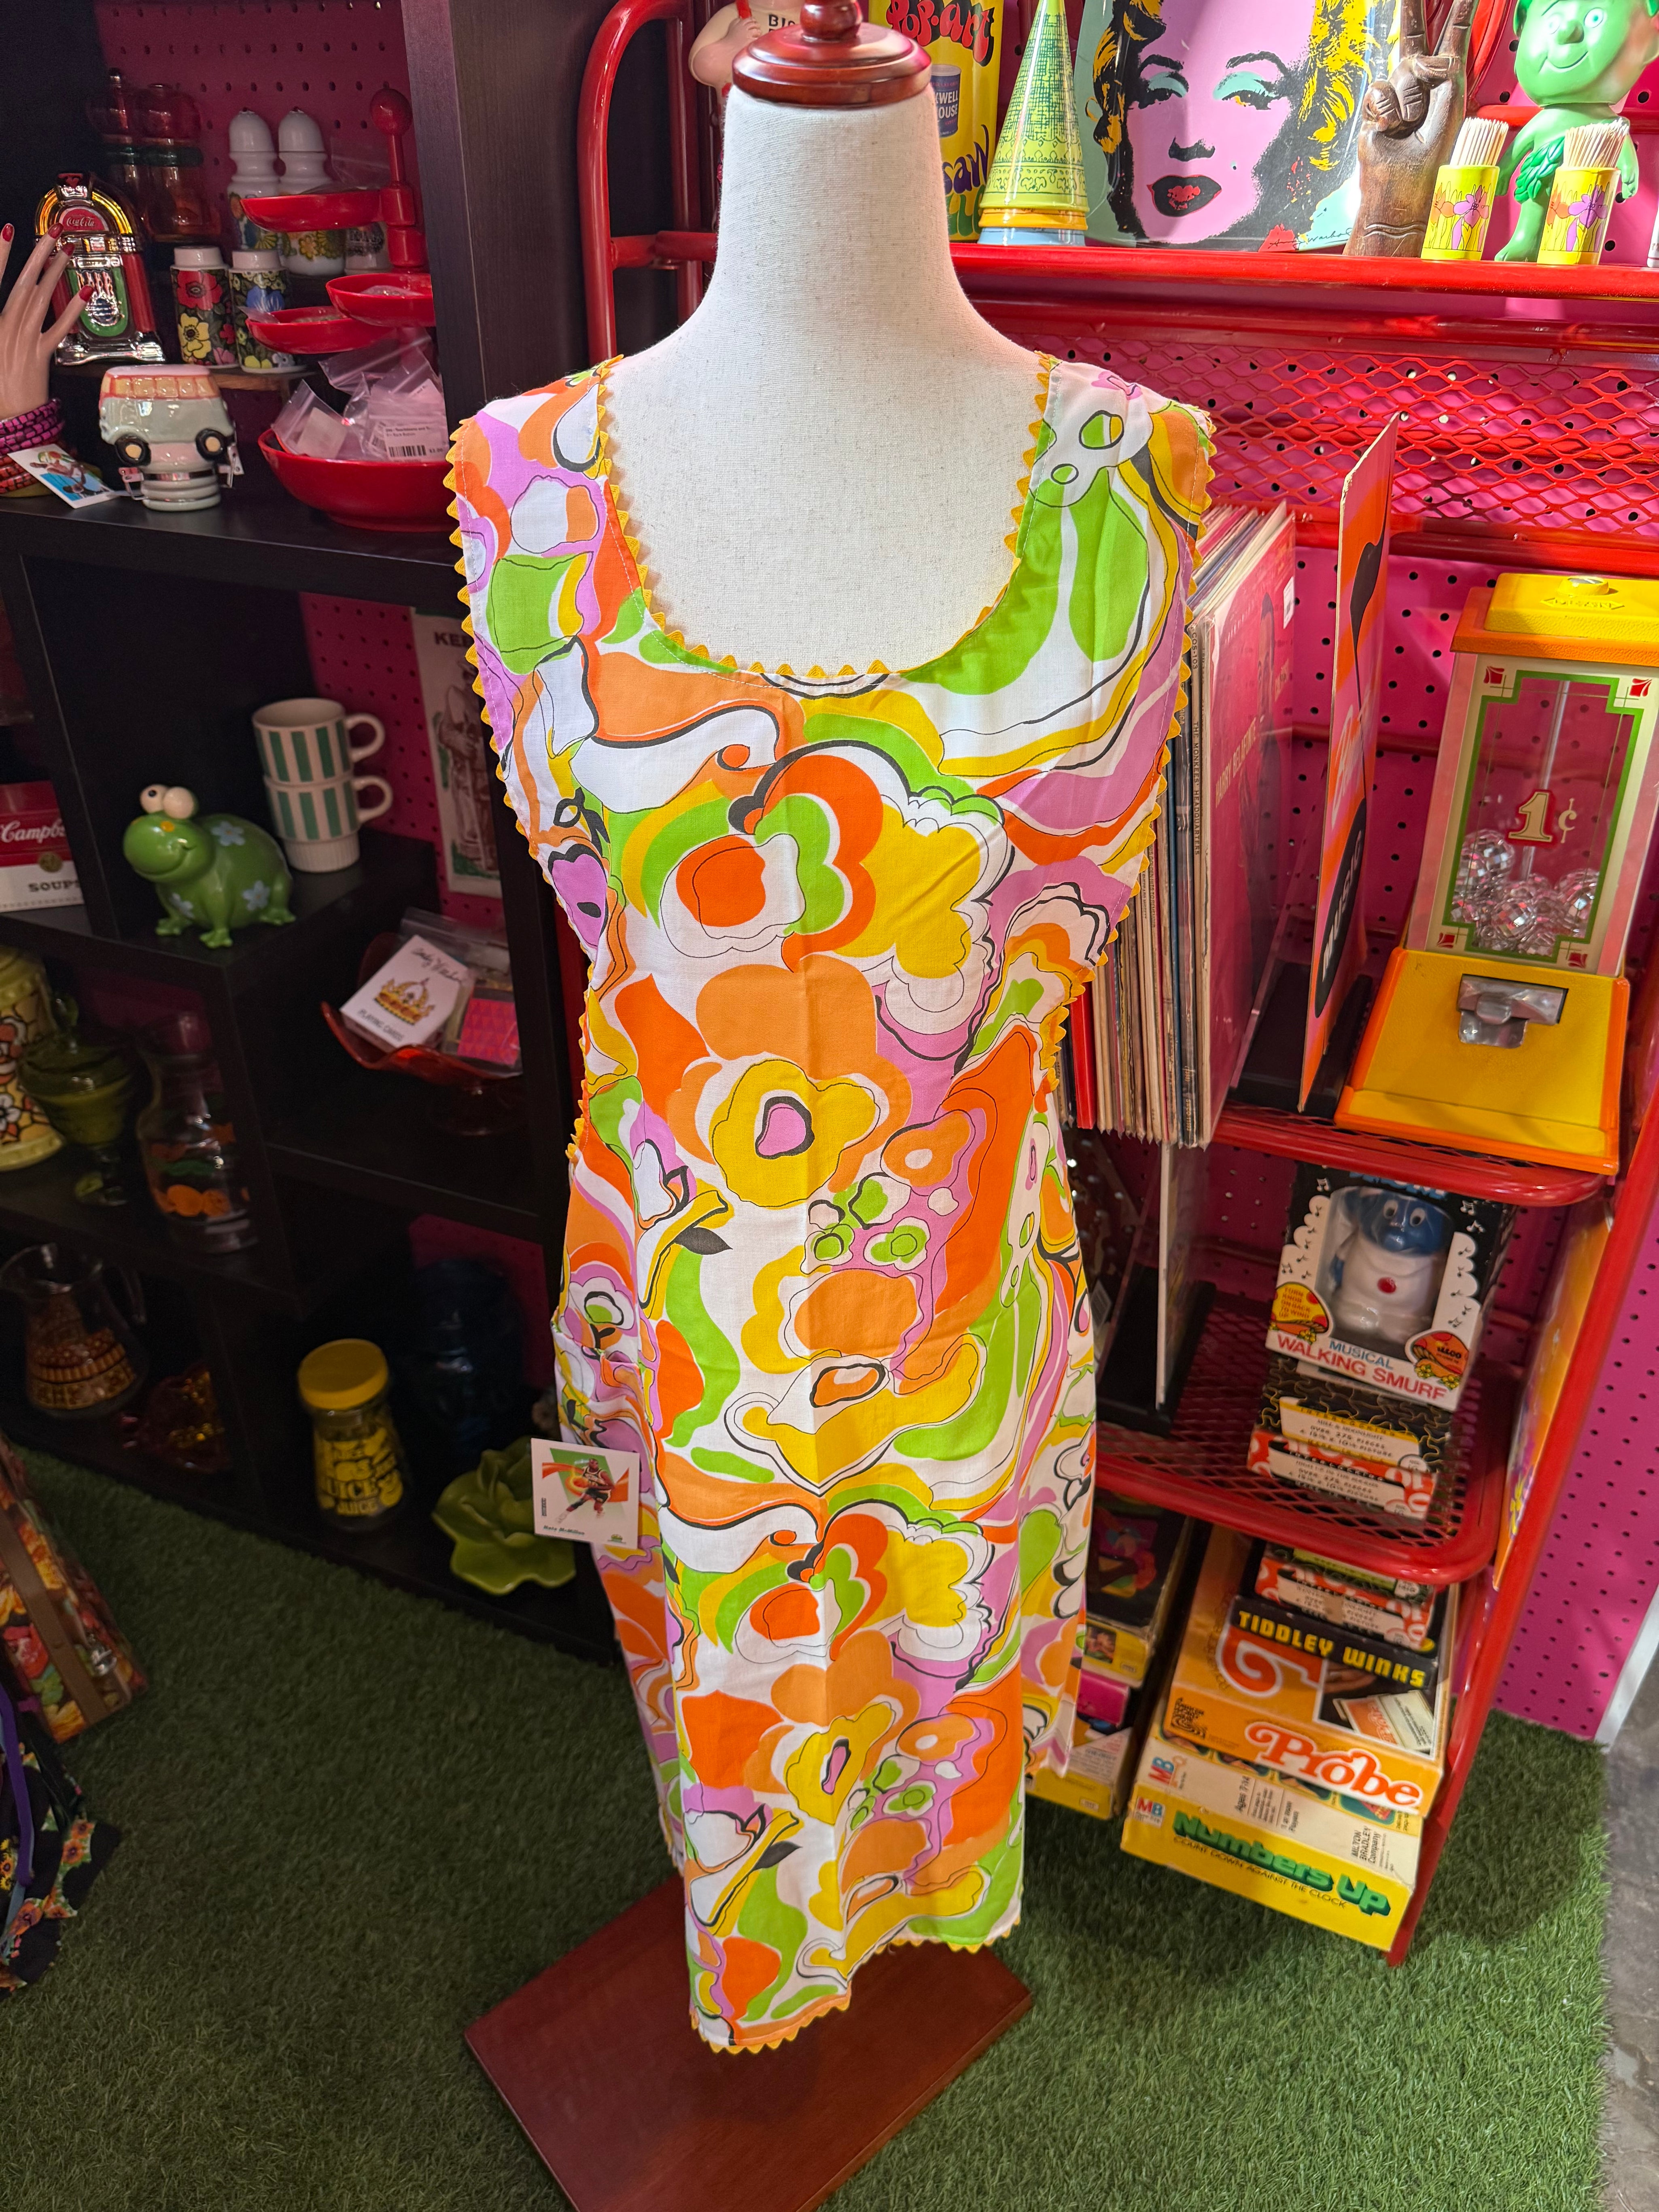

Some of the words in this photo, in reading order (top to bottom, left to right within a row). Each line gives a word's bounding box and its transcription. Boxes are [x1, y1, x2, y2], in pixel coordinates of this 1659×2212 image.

[938, 104, 958, 119] OUSE
[1322, 830, 1362, 982] MUSIC
[1277, 1333, 1366, 1376] WALKING
[1372, 1367, 1448, 1400] SMURF
[1329, 1340, 1394, 1369] MUSICAL
[1239, 1611, 1334, 1657] TIDDLEY
[1342, 1646, 1426, 1688] WINKS
[1148, 1756, 1174, 1786] MB
[1246, 1723, 1421, 1806] Probe
[1137, 1797, 1163, 1817] MB
[1235, 1792, 1246, 1812] Ages
[1351, 1830, 1362, 1857] MILTON
[1360, 1825, 1372, 1861] BRADLEY
[1368, 1831, 1382, 1864] Company
[1174, 1836, 1208, 1855] COUNT
[1211, 1848, 1243, 1868] DOWN
[1246, 1863, 1287, 1886] AGAINST
[1291, 1881, 1307, 1893] THE
[1309, 1888, 1347, 1909] CLOCK
